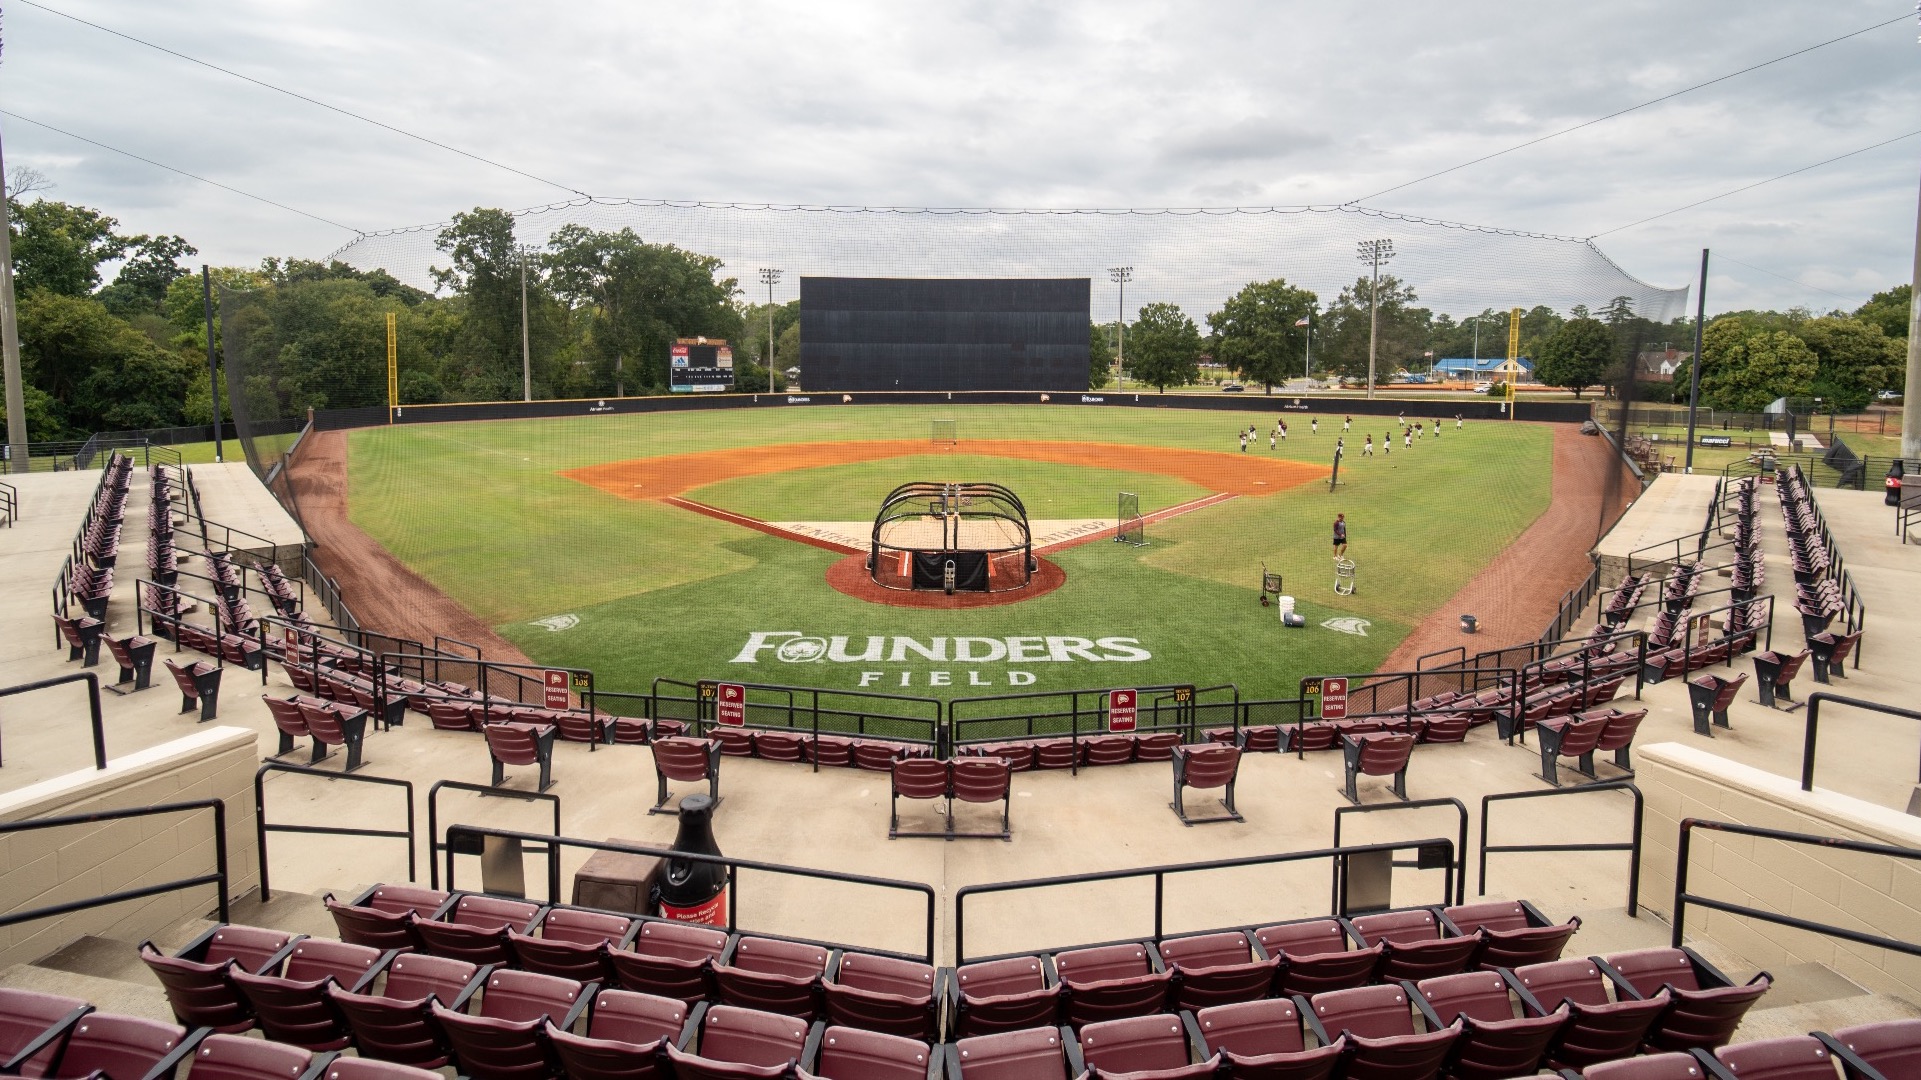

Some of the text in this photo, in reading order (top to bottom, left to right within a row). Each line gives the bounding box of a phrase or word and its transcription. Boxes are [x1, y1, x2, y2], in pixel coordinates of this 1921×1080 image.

[728, 631, 1152, 663] FOUNDERS
[575, 679, 589, 687] 108
[858, 671, 1037, 687] FIELD
[1306, 686, 1319, 694] 106
[1176, 693, 1190, 701] 107
[720, 701, 743, 709] RESERVED
[721, 710, 741, 718] SEATING
[1112, 716, 1133, 724] SEATING
[698, 902, 719, 917] Recycle
